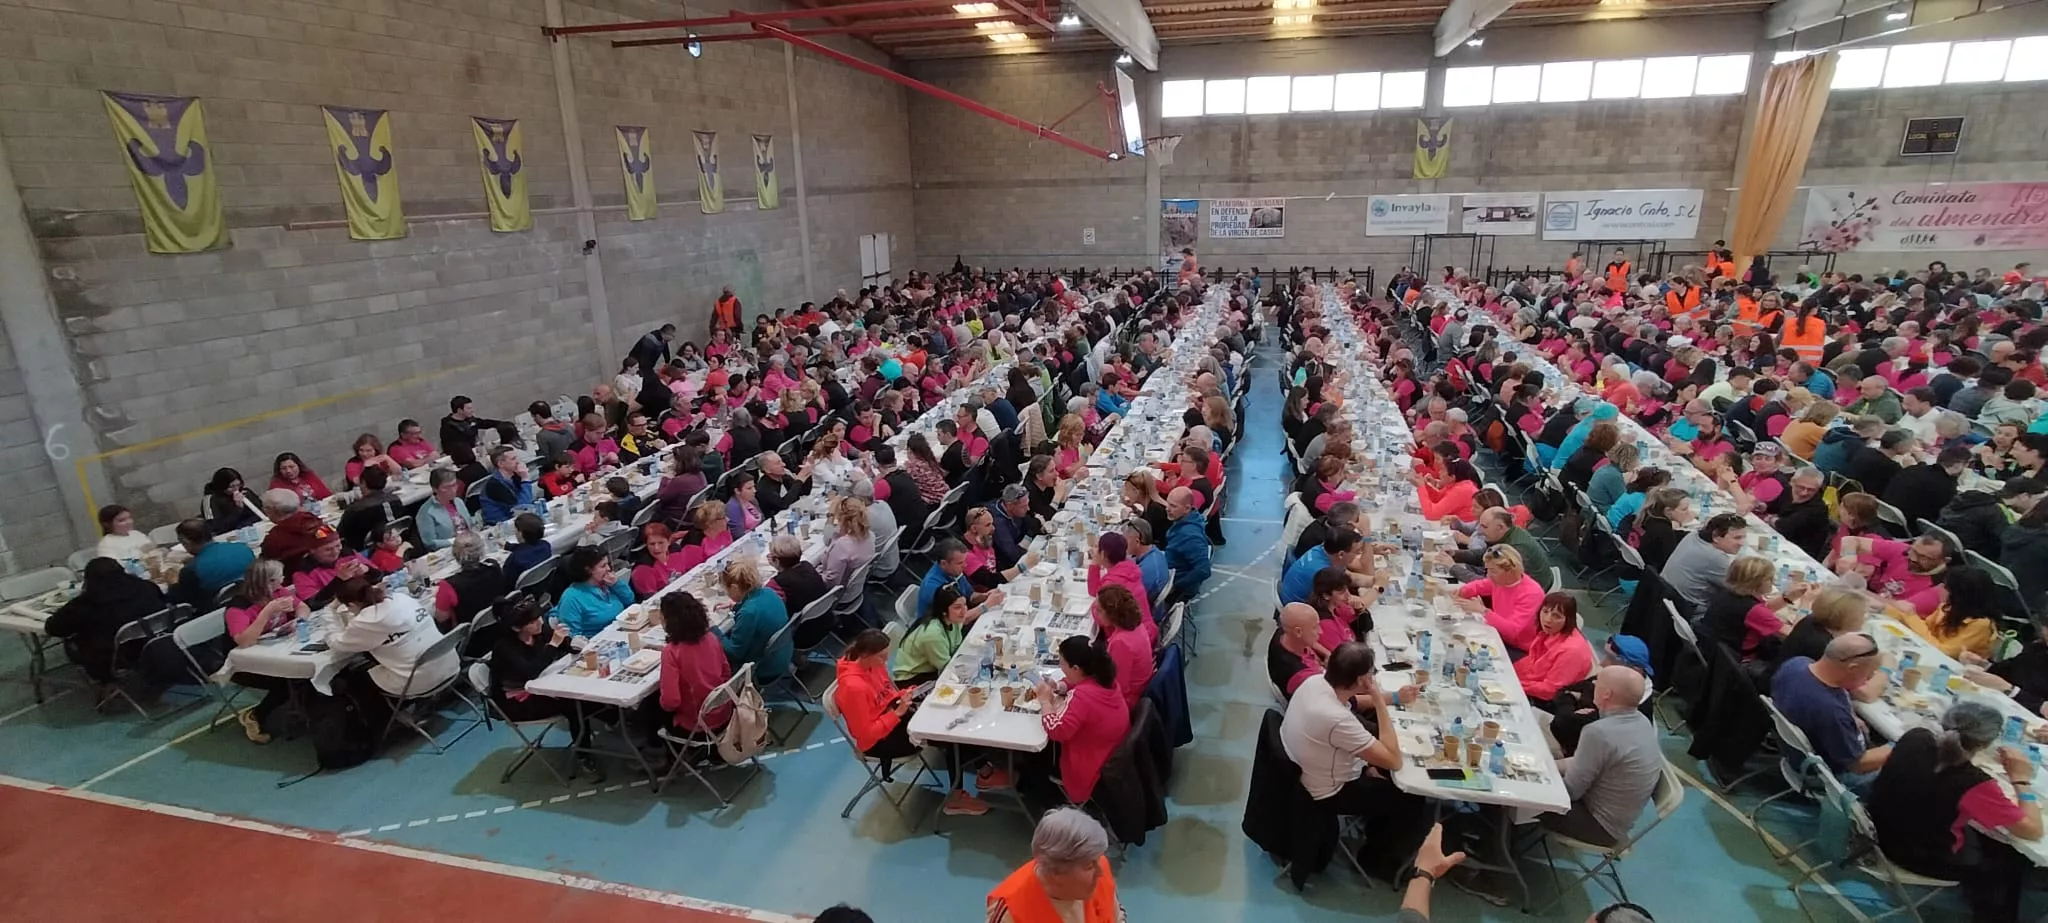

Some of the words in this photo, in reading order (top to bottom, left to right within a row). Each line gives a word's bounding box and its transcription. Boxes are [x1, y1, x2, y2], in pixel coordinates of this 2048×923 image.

[1892, 190, 1977, 205] Caminata
[1221, 207, 1248, 215] DEFENSA
[1391, 202, 1432, 214] Invayla
[1584, 199, 1633, 220] Ignacio
[45, 423, 70, 460] 6
